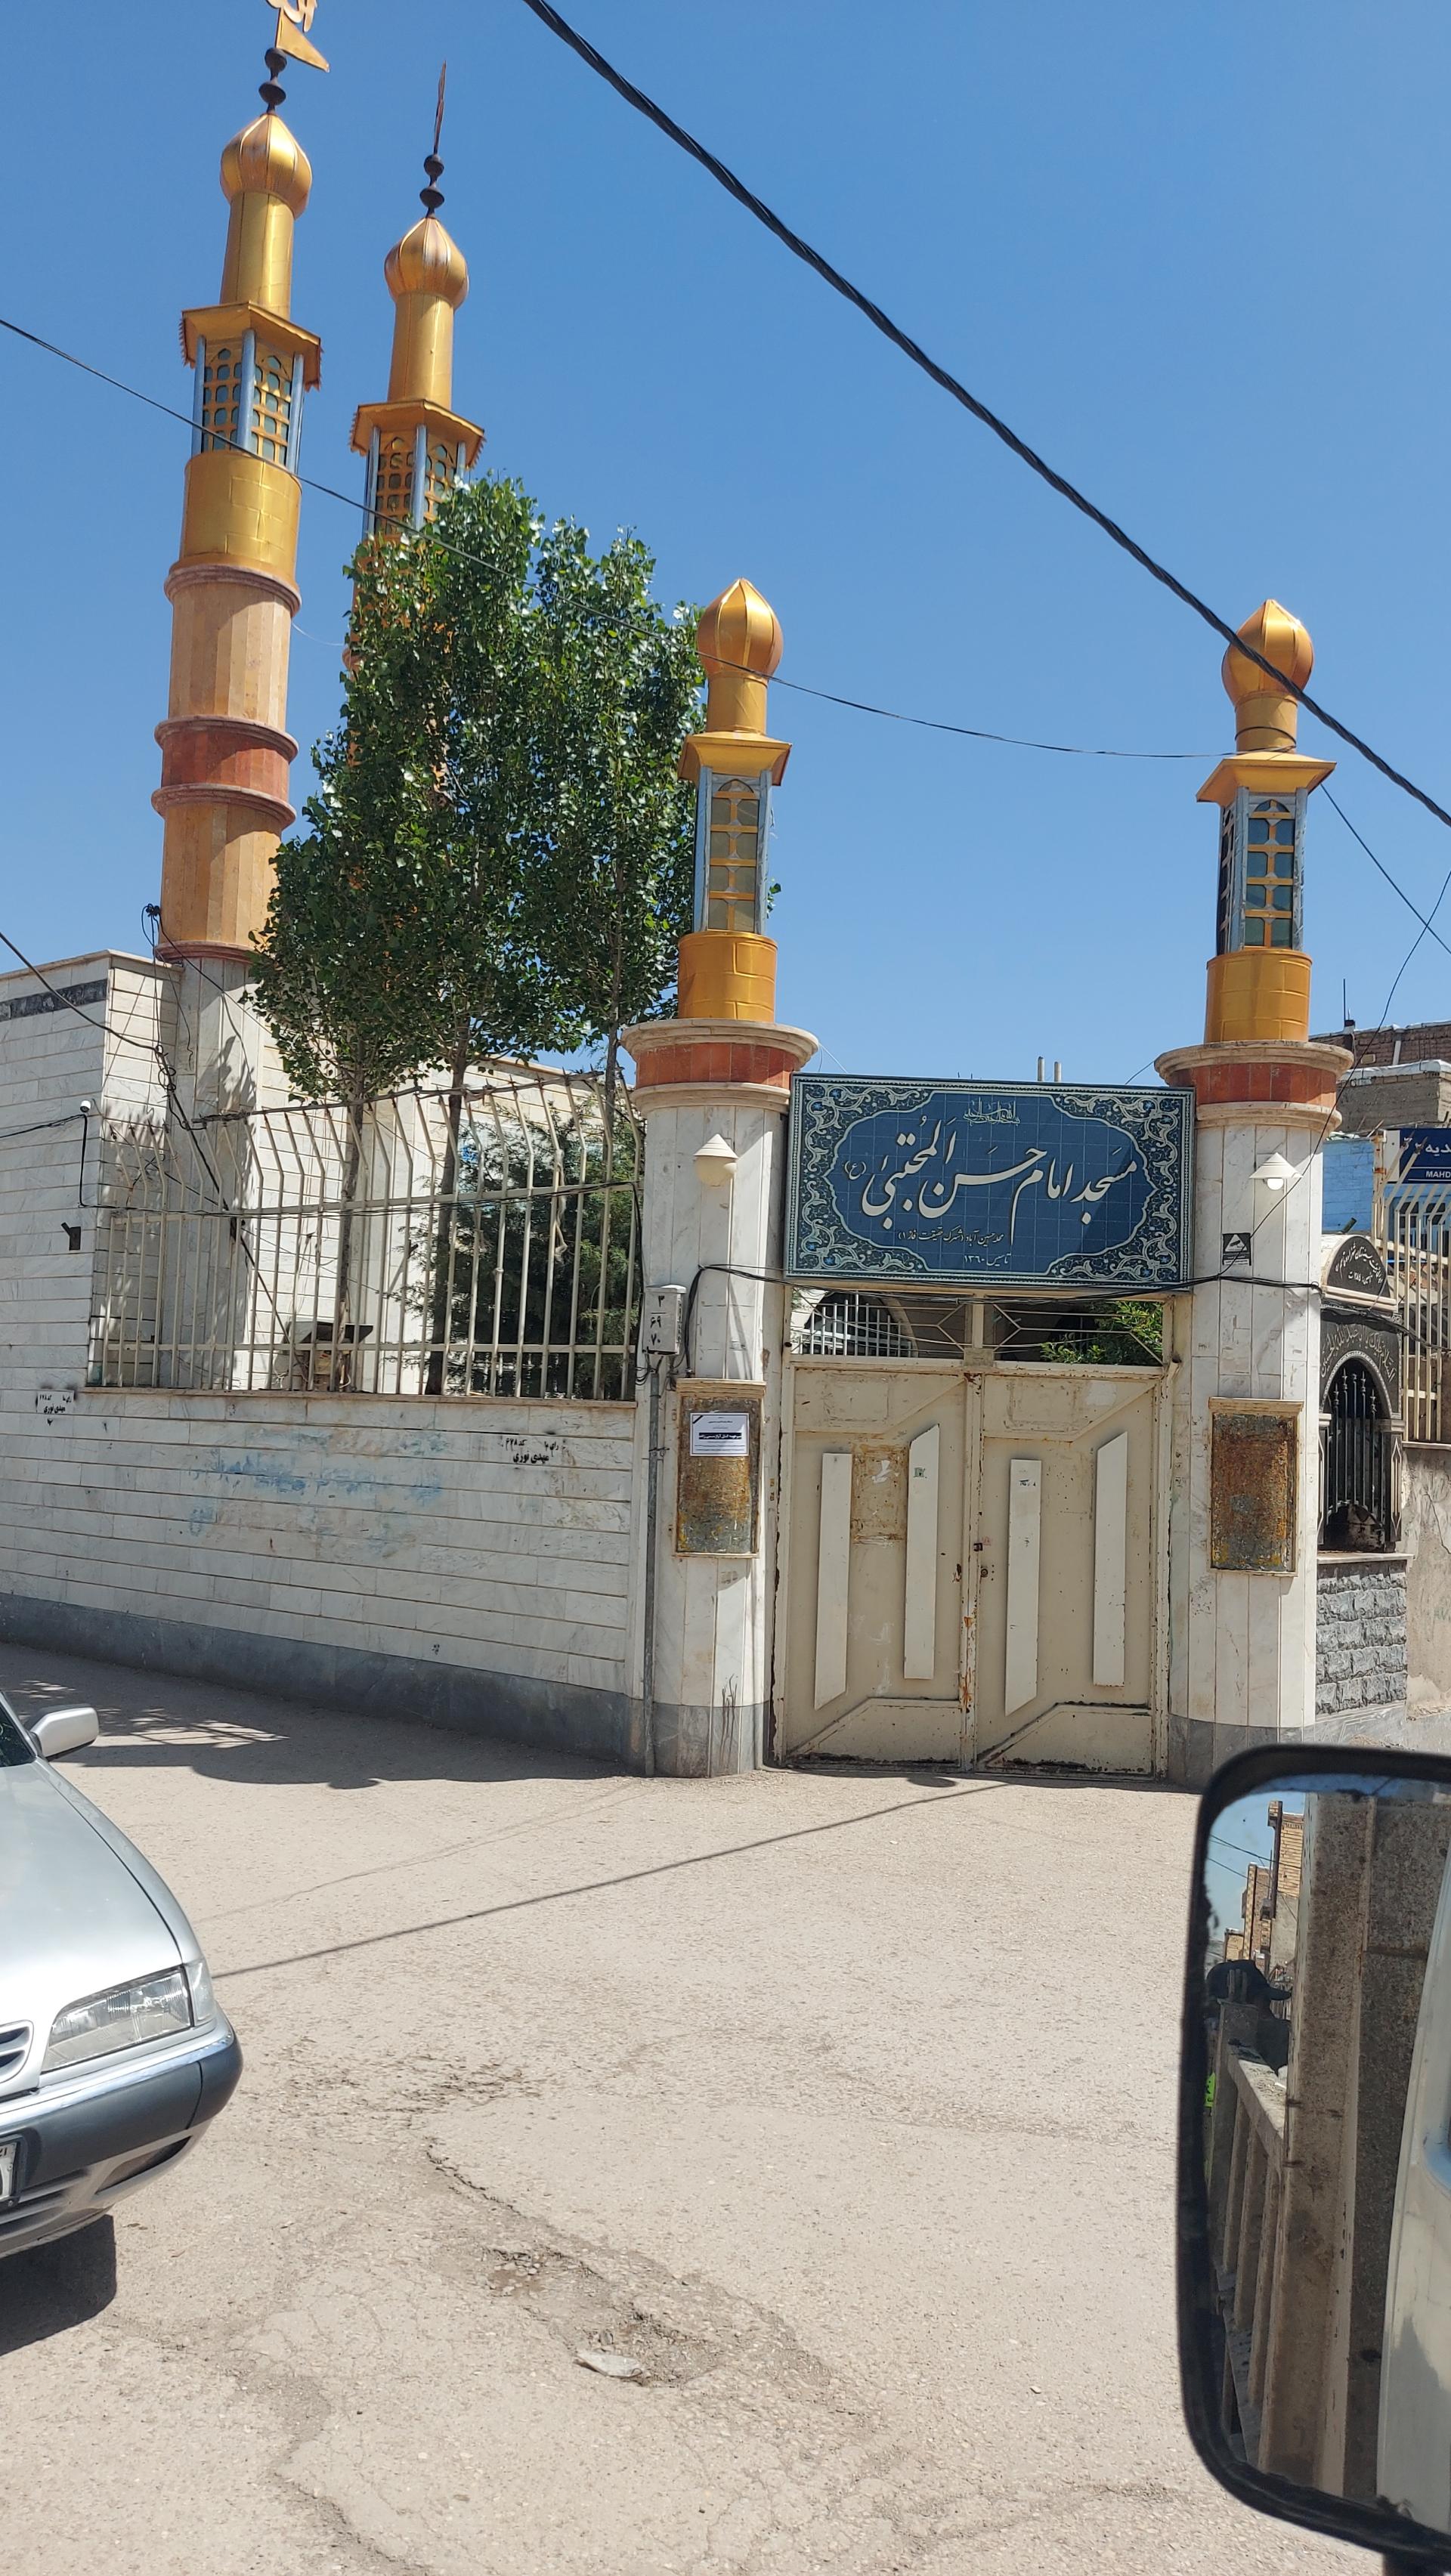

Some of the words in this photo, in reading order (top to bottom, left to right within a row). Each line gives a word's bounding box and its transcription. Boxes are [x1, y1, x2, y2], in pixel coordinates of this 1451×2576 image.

[1010, 1158, 1073, 1245] امام
[513, 1450, 530, 1464] نوری
[531, 1453, 549, 1464] مهدی
